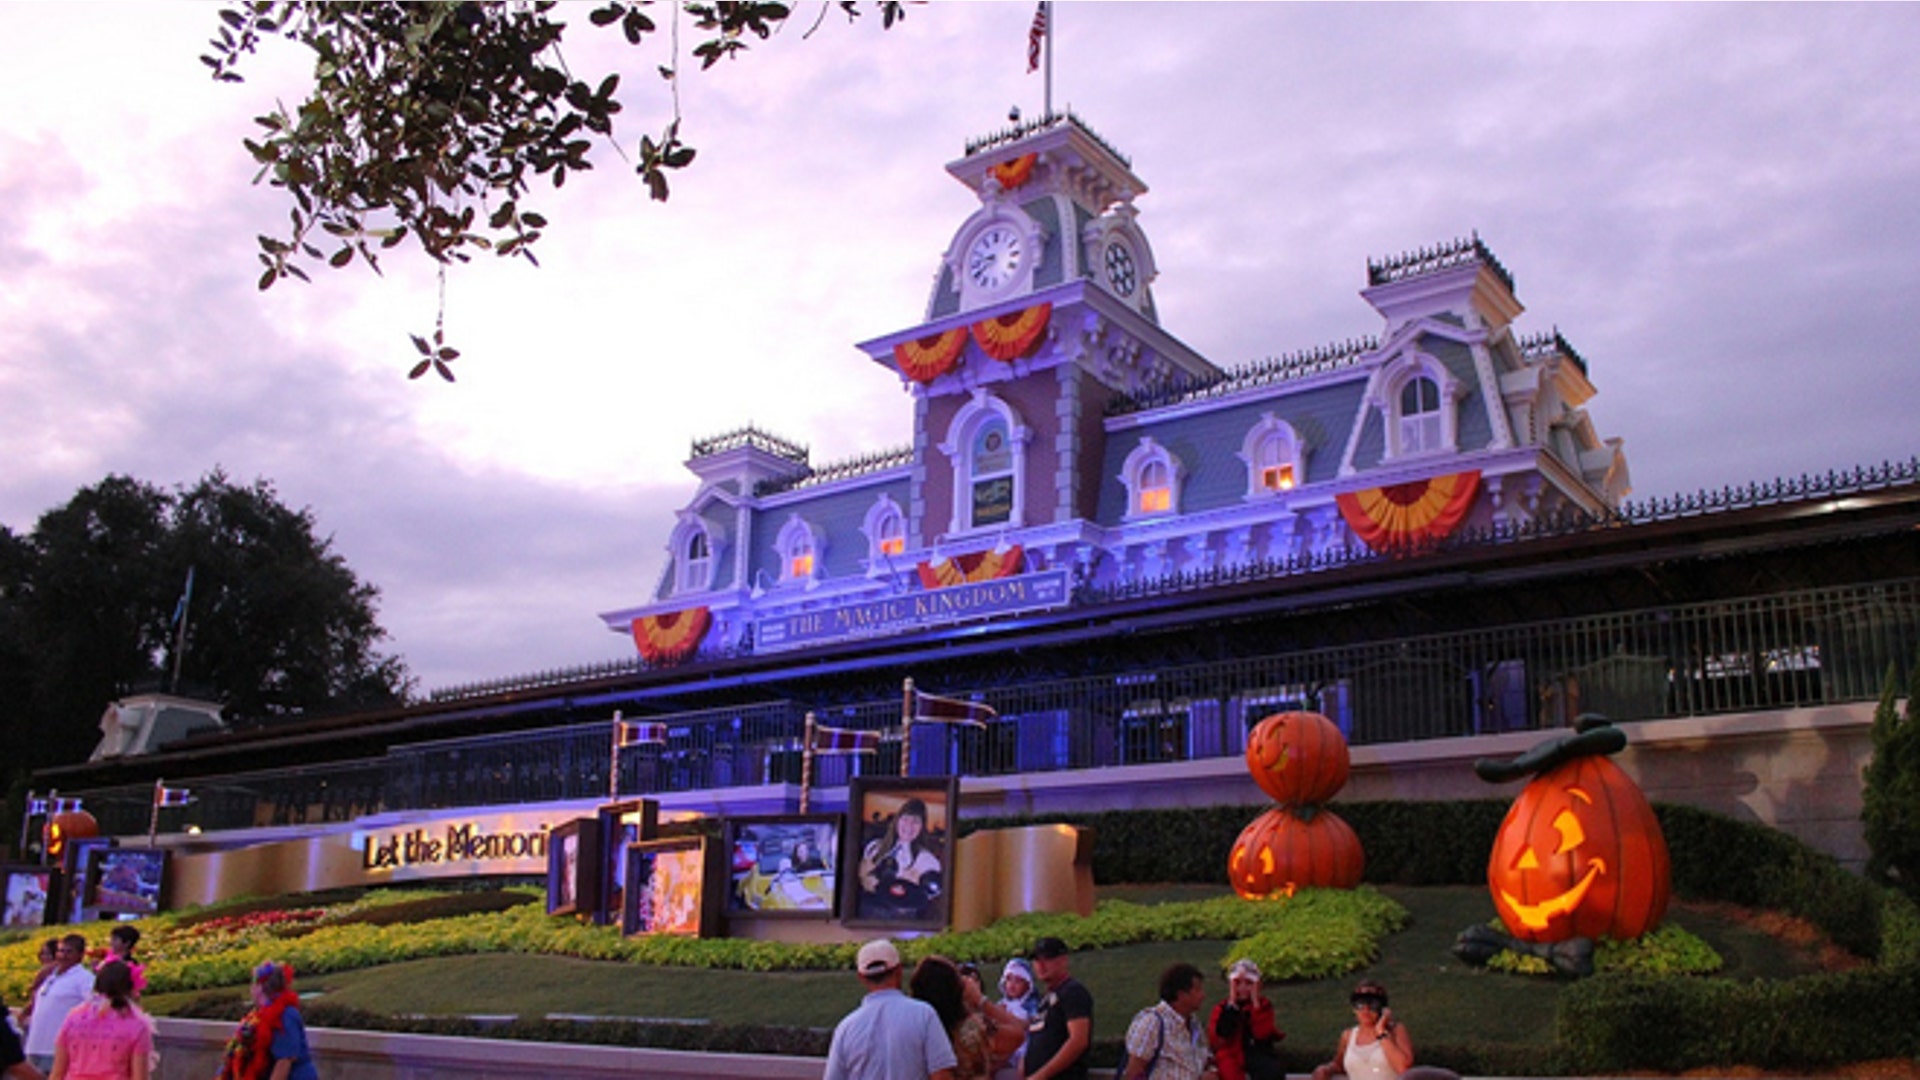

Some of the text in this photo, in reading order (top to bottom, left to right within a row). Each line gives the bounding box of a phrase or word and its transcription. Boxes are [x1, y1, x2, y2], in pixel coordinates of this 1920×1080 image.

[790, 614, 824, 636] THE
[835, 602, 905, 628] MAGIC
[914, 582, 1025, 612] KINGDOM
[364, 834, 399, 868] Let
[406, 828, 442, 863] the
